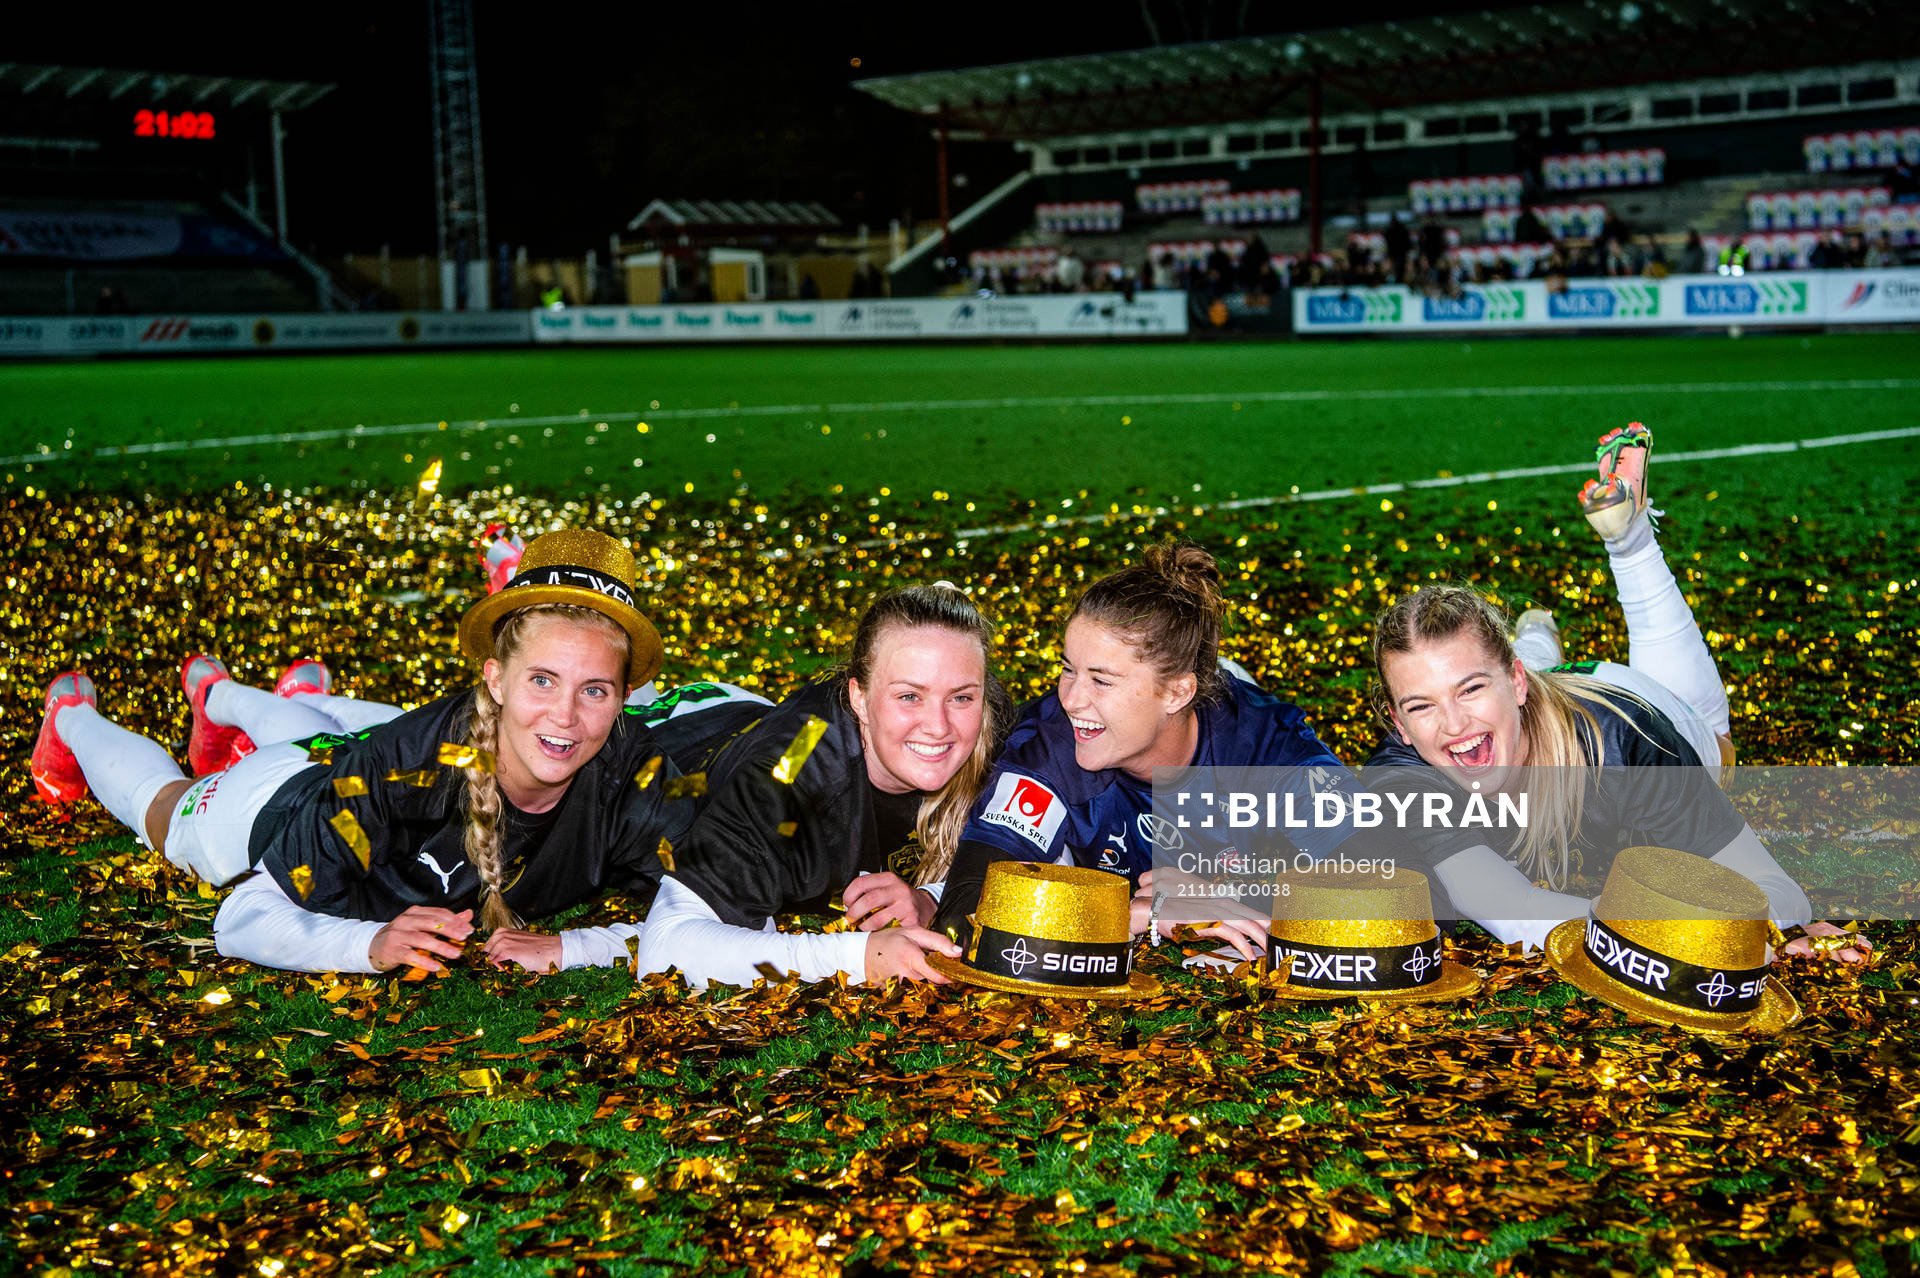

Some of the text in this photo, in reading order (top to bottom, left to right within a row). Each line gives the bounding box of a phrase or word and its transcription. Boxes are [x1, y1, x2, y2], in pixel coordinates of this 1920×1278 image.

[134, 109, 216, 139] 21:02
[1692, 287, 1752, 312] MKB
[984, 812, 1047, 848] SVENSKA SPEL
